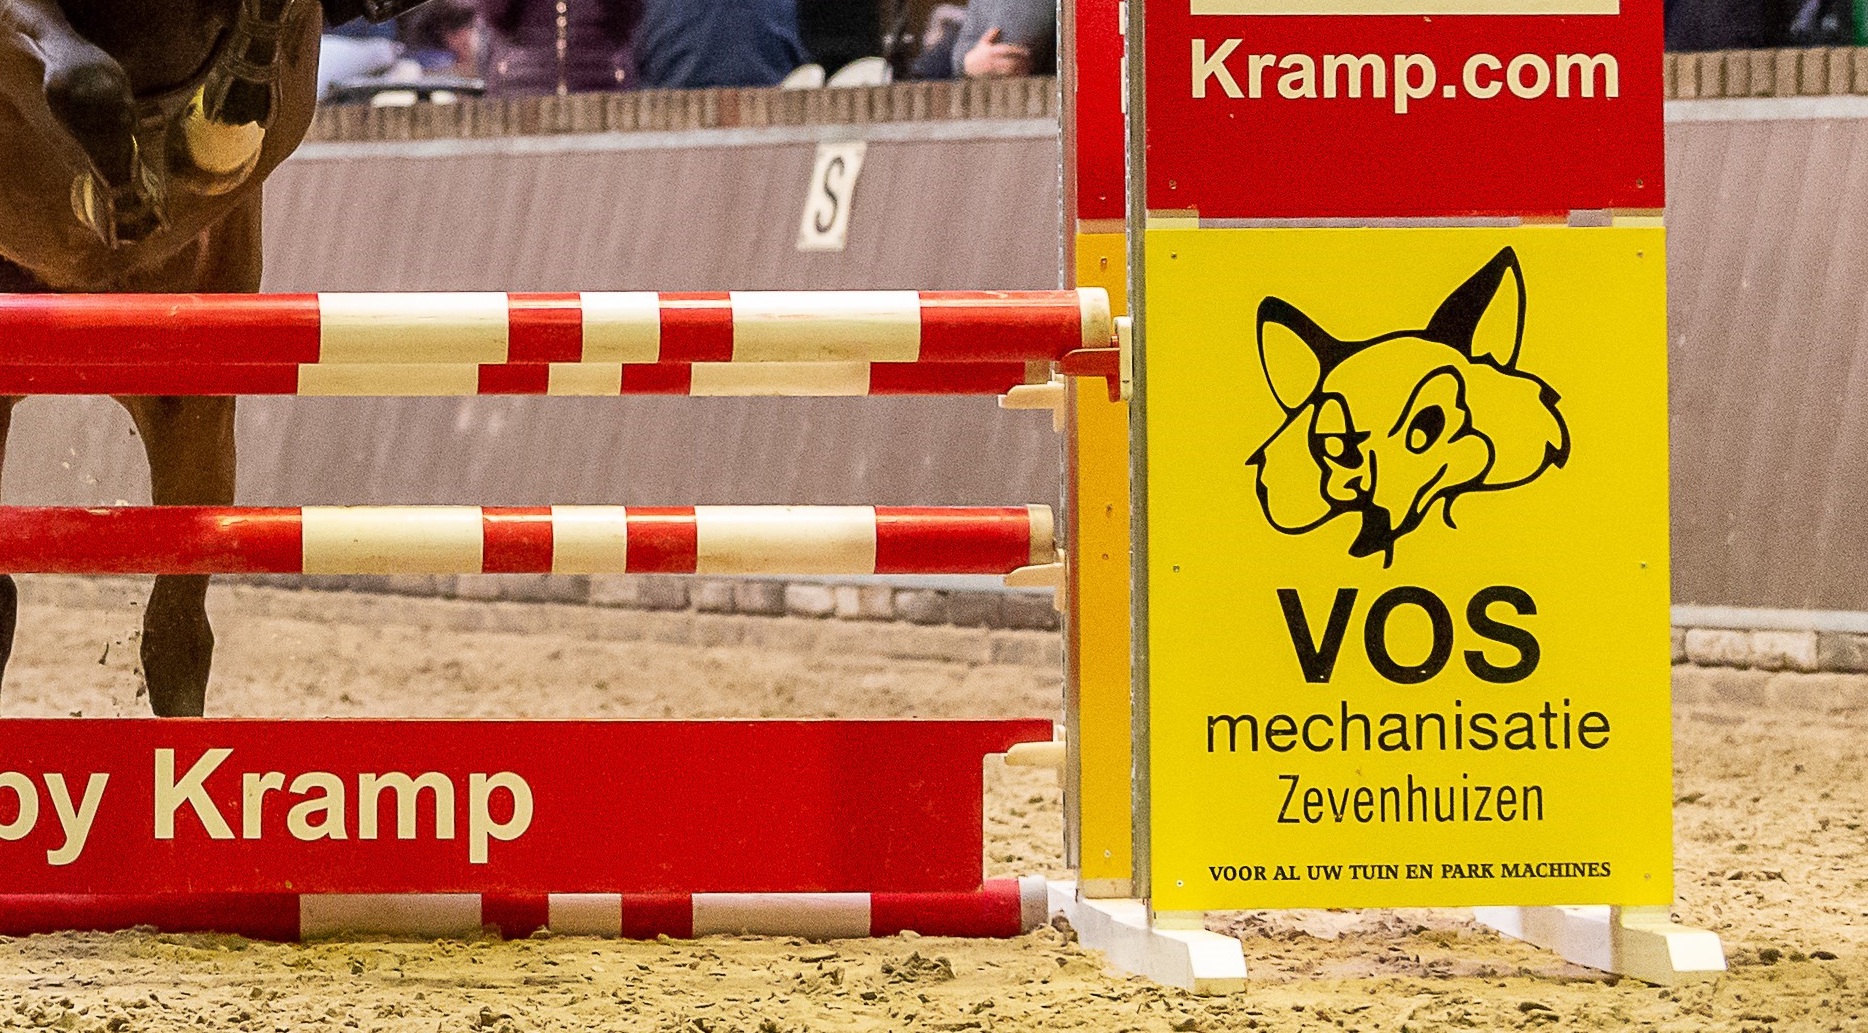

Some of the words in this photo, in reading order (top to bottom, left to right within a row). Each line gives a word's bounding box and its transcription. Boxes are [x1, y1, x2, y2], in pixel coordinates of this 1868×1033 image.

[1191, 38, 1619, 114] Kramp.com
[814, 155, 846, 234] S
[1276, 585, 1541, 685] VOS
[1207, 698, 1611, 753] mechanisatie
[154, 748, 534, 864] Kramp
[1277, 773, 1544, 824] Zevenhuizen
[1208, 865, 1267, 881] VOOR
[1272, 865, 1301, 881] AL
[1306, 865, 1343, 881] UW
[1348, 864, 1399, 880] TUIN
[1405, 864, 1434, 880] EN
[1441, 863, 1495, 879] PARK
[1500, 862, 1611, 878] MACHINES
